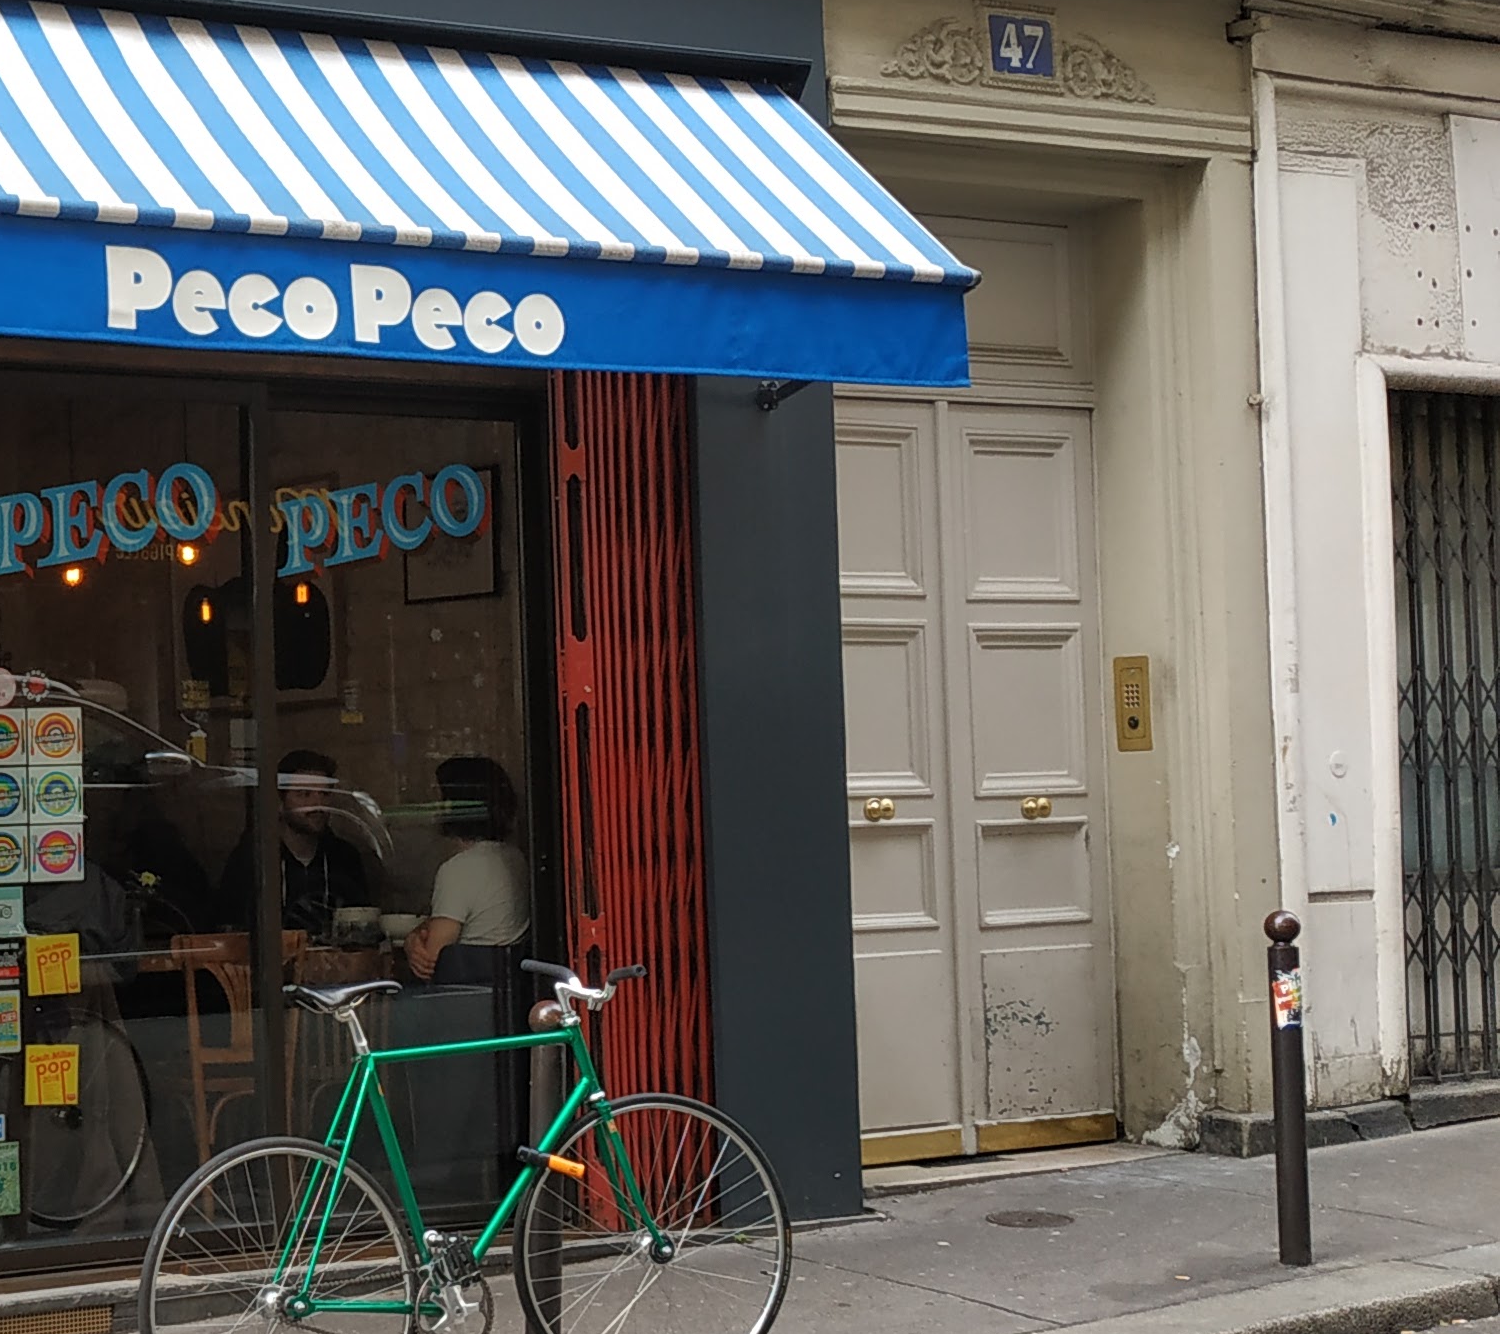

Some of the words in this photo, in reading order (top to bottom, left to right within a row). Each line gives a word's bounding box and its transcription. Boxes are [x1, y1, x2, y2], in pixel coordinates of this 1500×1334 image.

[1000, 23, 1044, 69] 47
[104, 244, 339, 341] Peco
[349, 263, 566, 357] Peco
[277, 463, 487, 579] PECO
